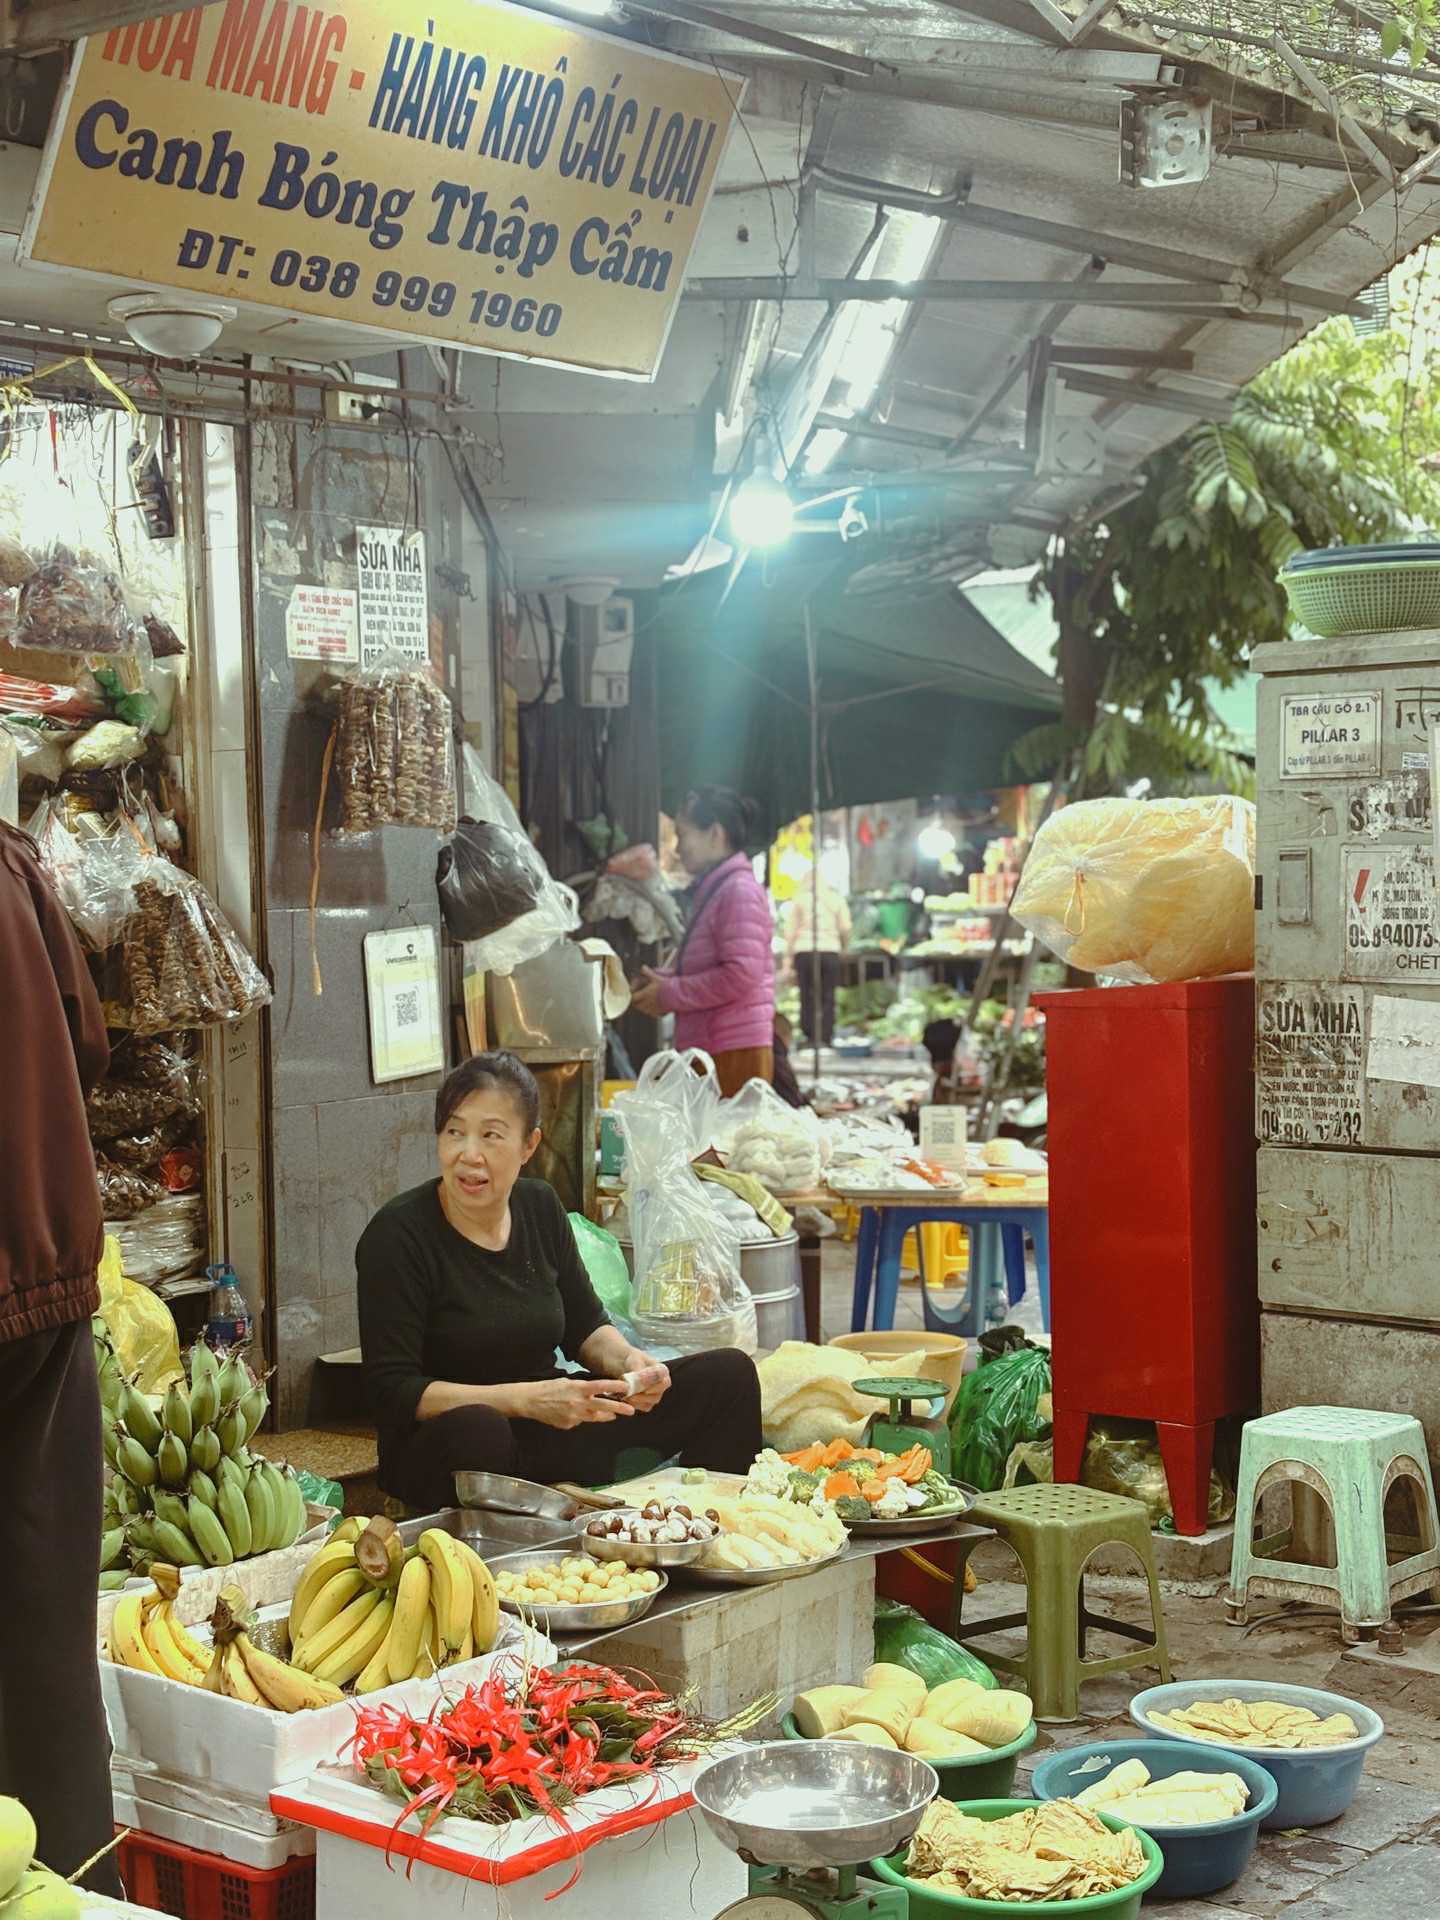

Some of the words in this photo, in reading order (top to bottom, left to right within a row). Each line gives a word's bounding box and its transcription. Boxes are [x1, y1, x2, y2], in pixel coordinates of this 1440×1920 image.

[75, 99, 245, 199] Canh
[257, 141, 415, 249] Bóng
[427, 180, 559, 278] Thập
[570, 209, 673, 292] Cẩm
[478, 56, 568, 169] KHÔ
[559, 73, 638, 188] CÁC
[629, 106, 717, 224] LOẠI
[177, 228, 256, 279] ĐT:
[270, 249, 360, 298] 038
[372, 270, 457, 318] 999
[469, 290, 562, 337] 1960
[1302, 728, 1347, 743] PILLAR
[1351, 728, 1360, 741] 3
